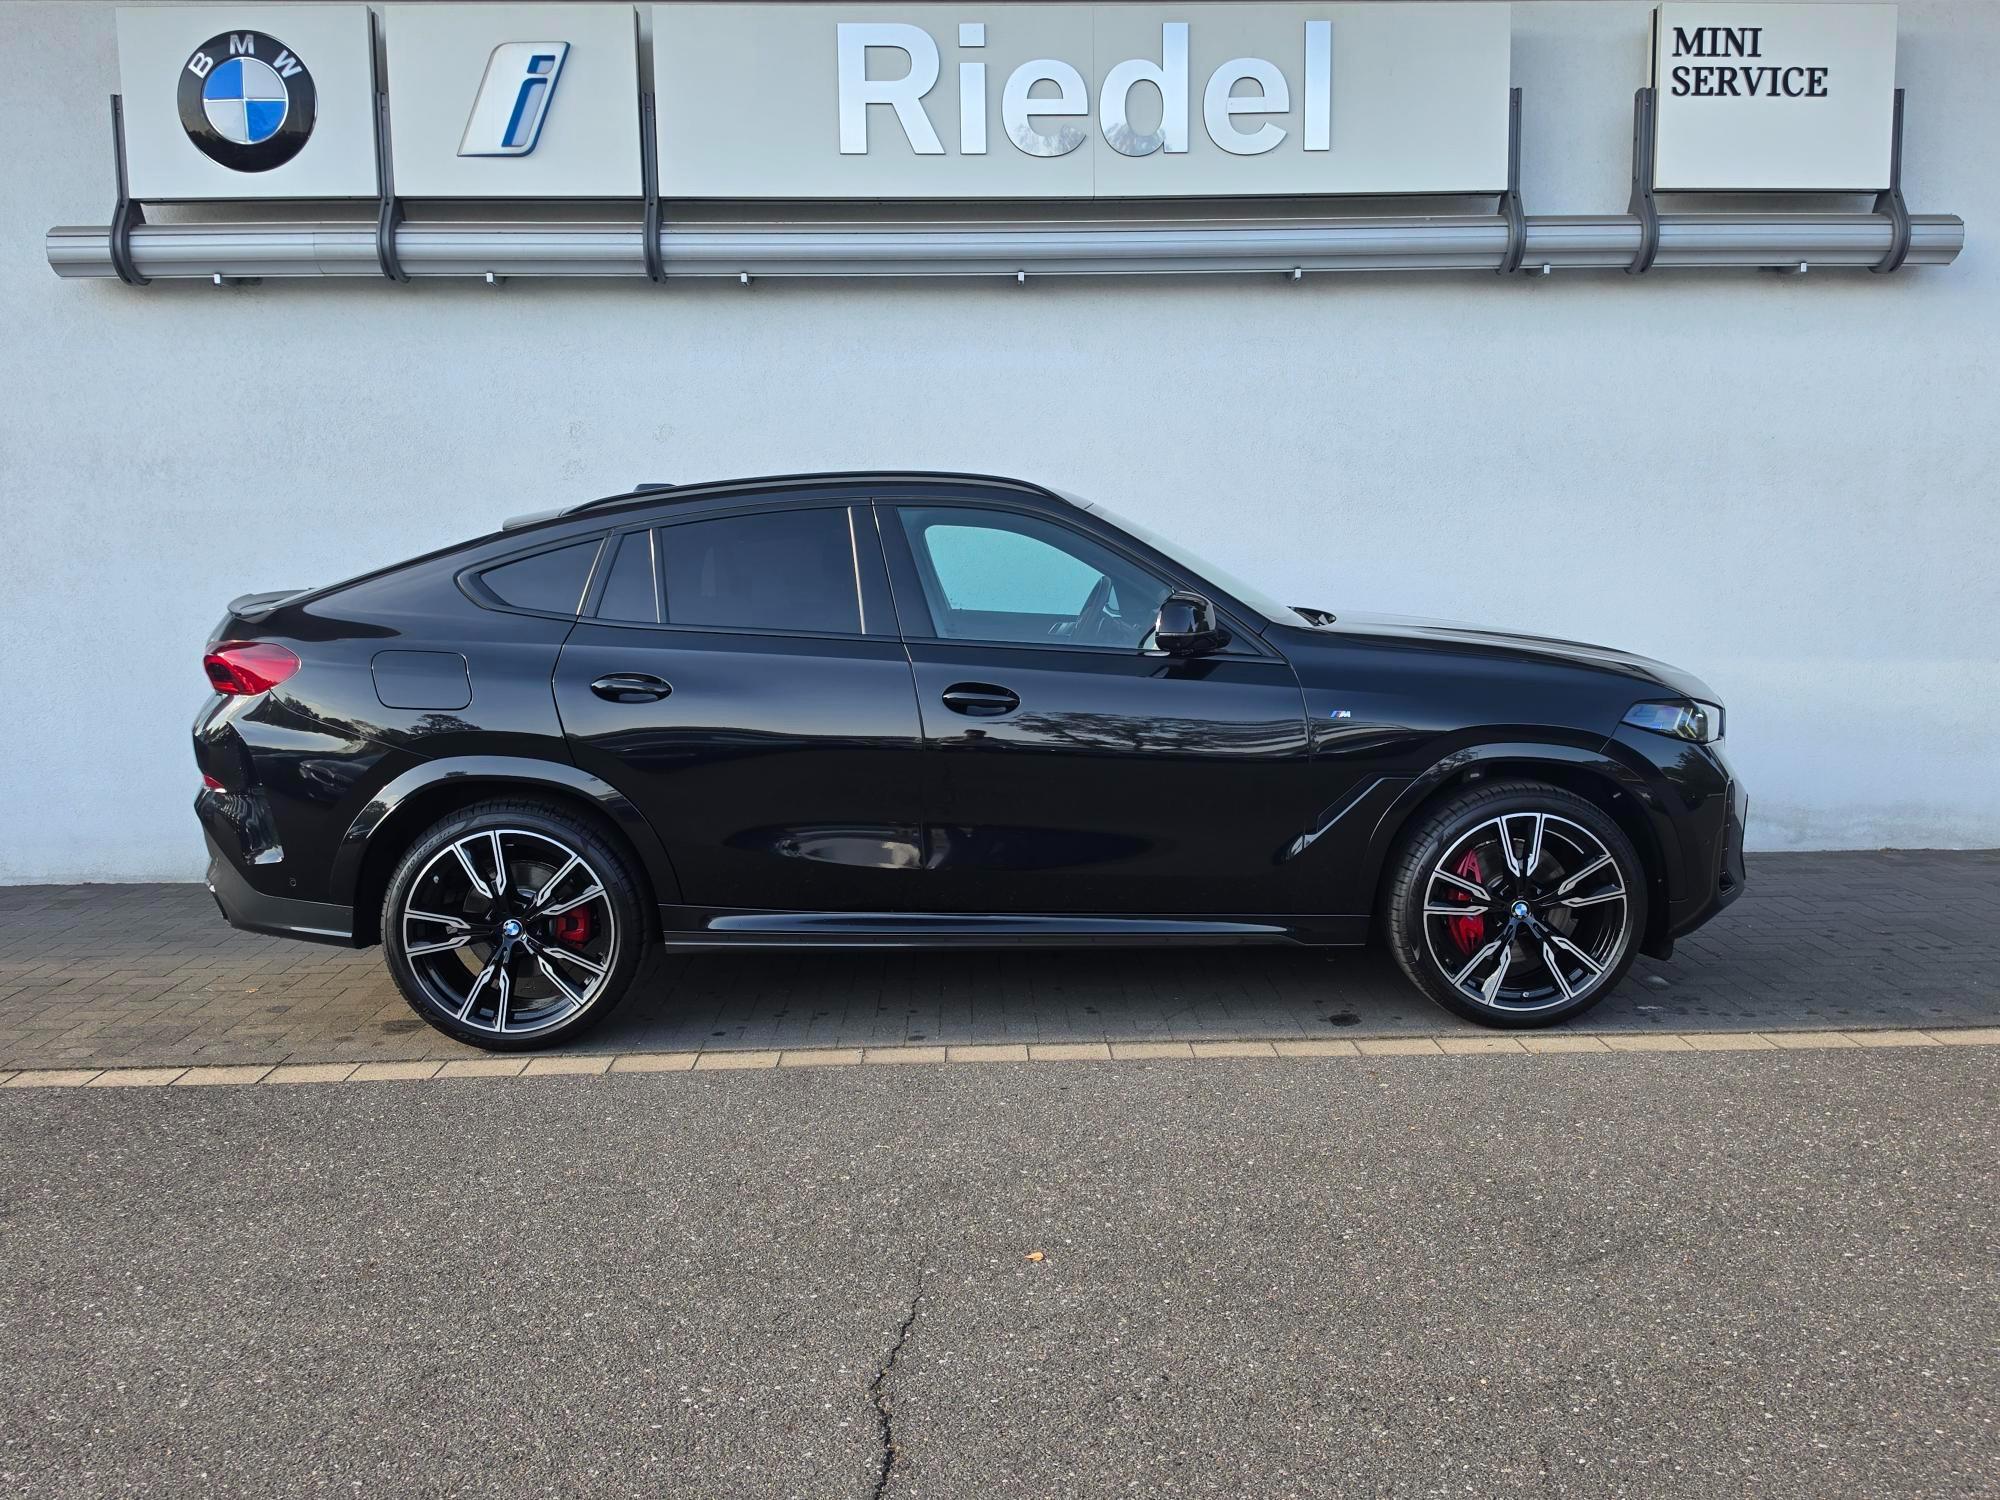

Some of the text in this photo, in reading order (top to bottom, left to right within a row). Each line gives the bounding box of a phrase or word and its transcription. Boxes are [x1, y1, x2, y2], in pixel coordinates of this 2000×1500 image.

[188, 34, 302, 79] BMW
[1672, 27, 1762, 57] MINI
[836, 20, 1332, 157] Riedel
[1671, 66, 1828, 97] SERVICE
